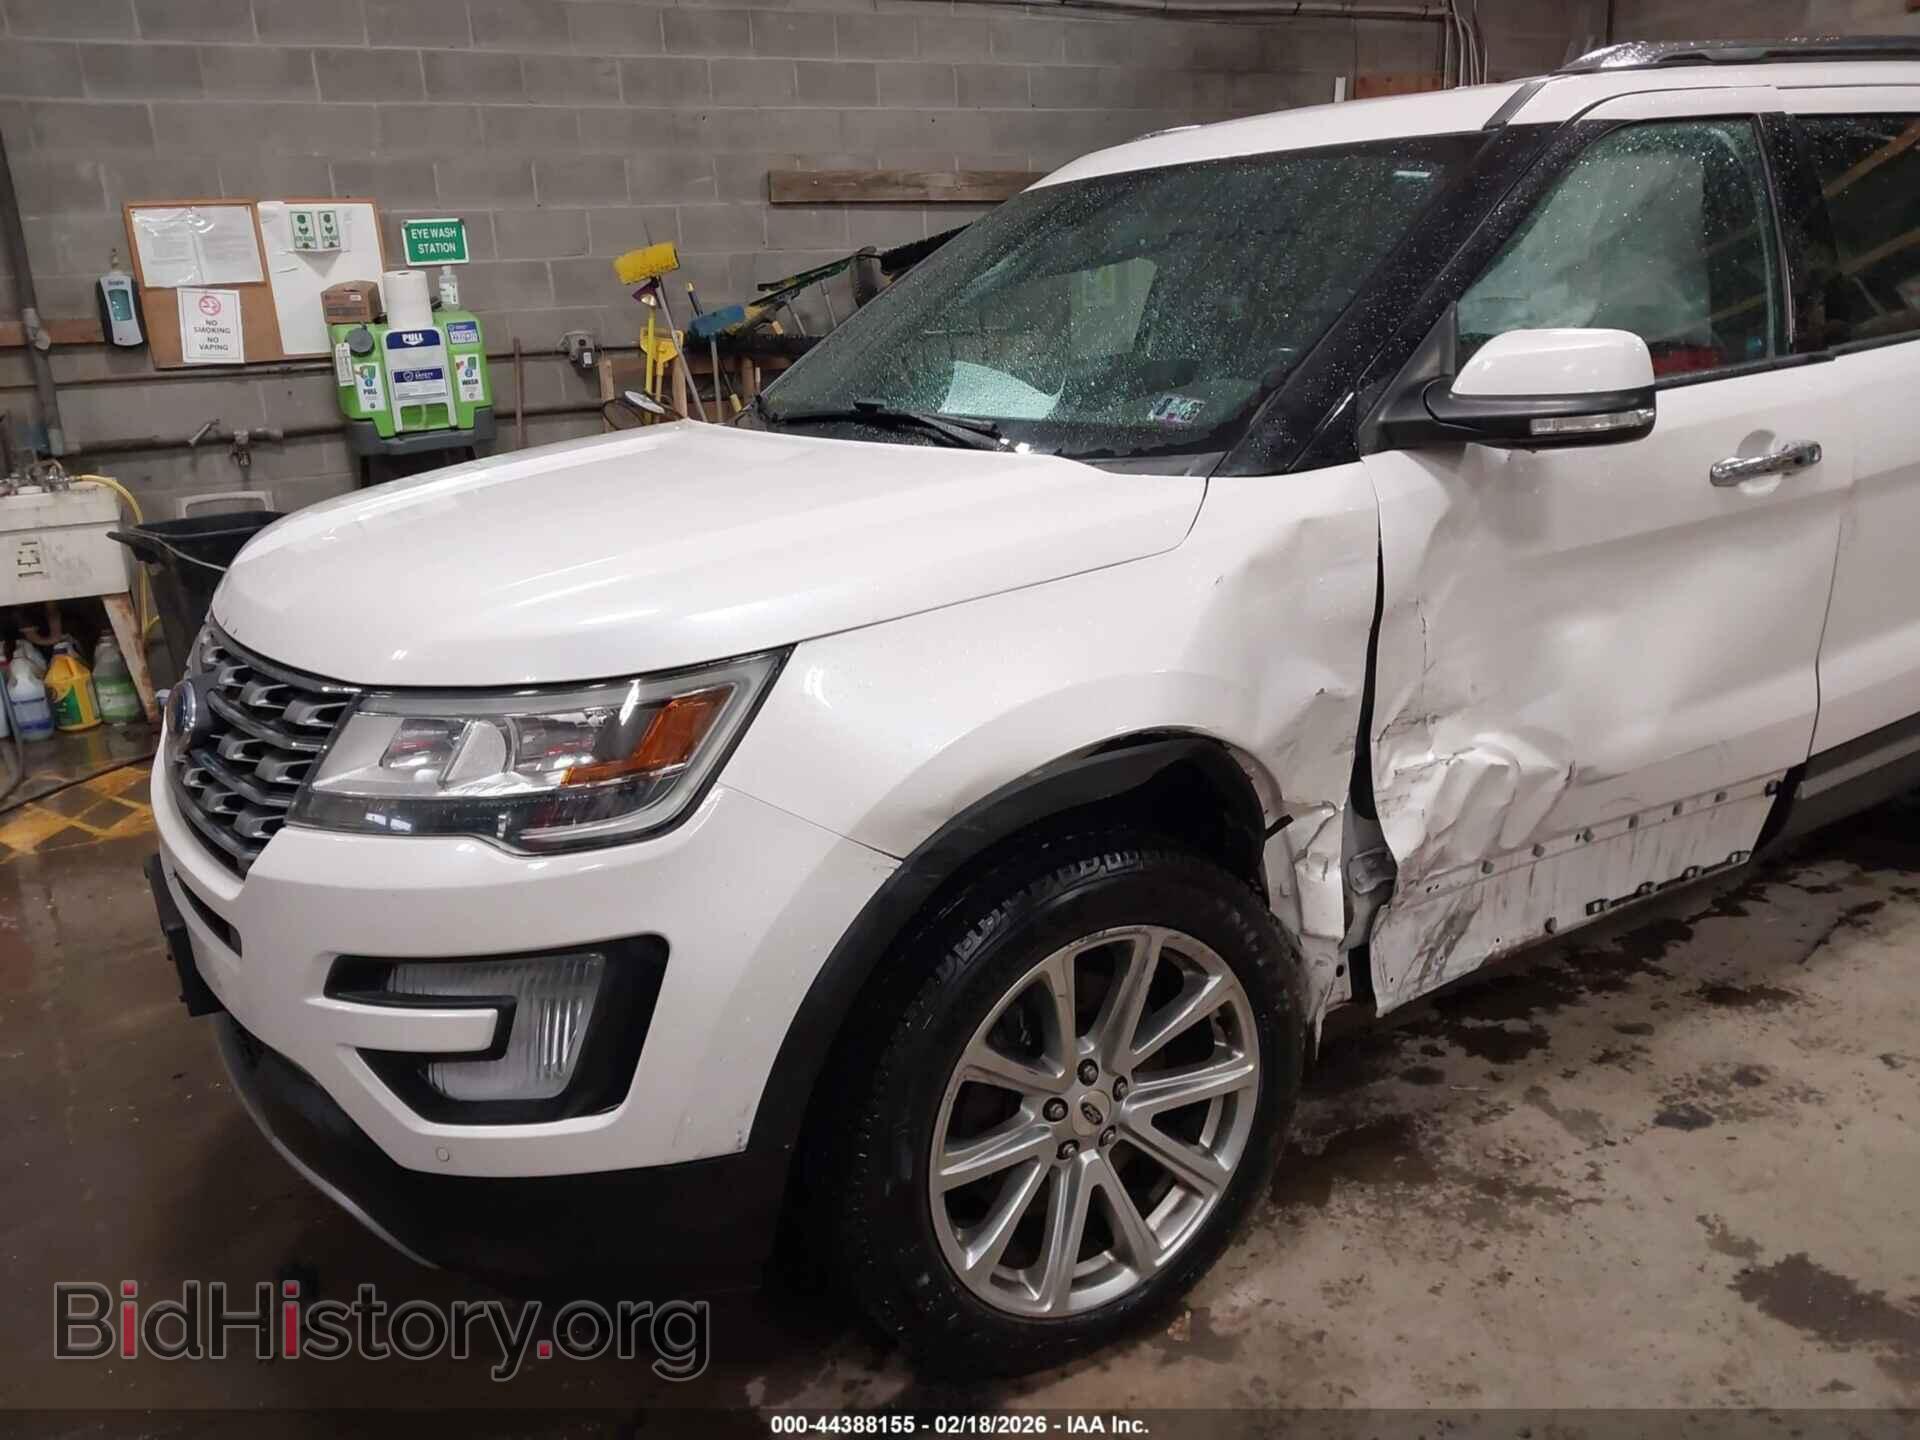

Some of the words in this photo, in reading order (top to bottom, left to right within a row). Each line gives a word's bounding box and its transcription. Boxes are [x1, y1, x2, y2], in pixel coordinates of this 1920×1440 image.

[411, 228, 430, 239] EYE
[430, 227, 457, 238] WASH
[417, 242, 456, 254] STATION
[402, 333, 424, 342] PULL
